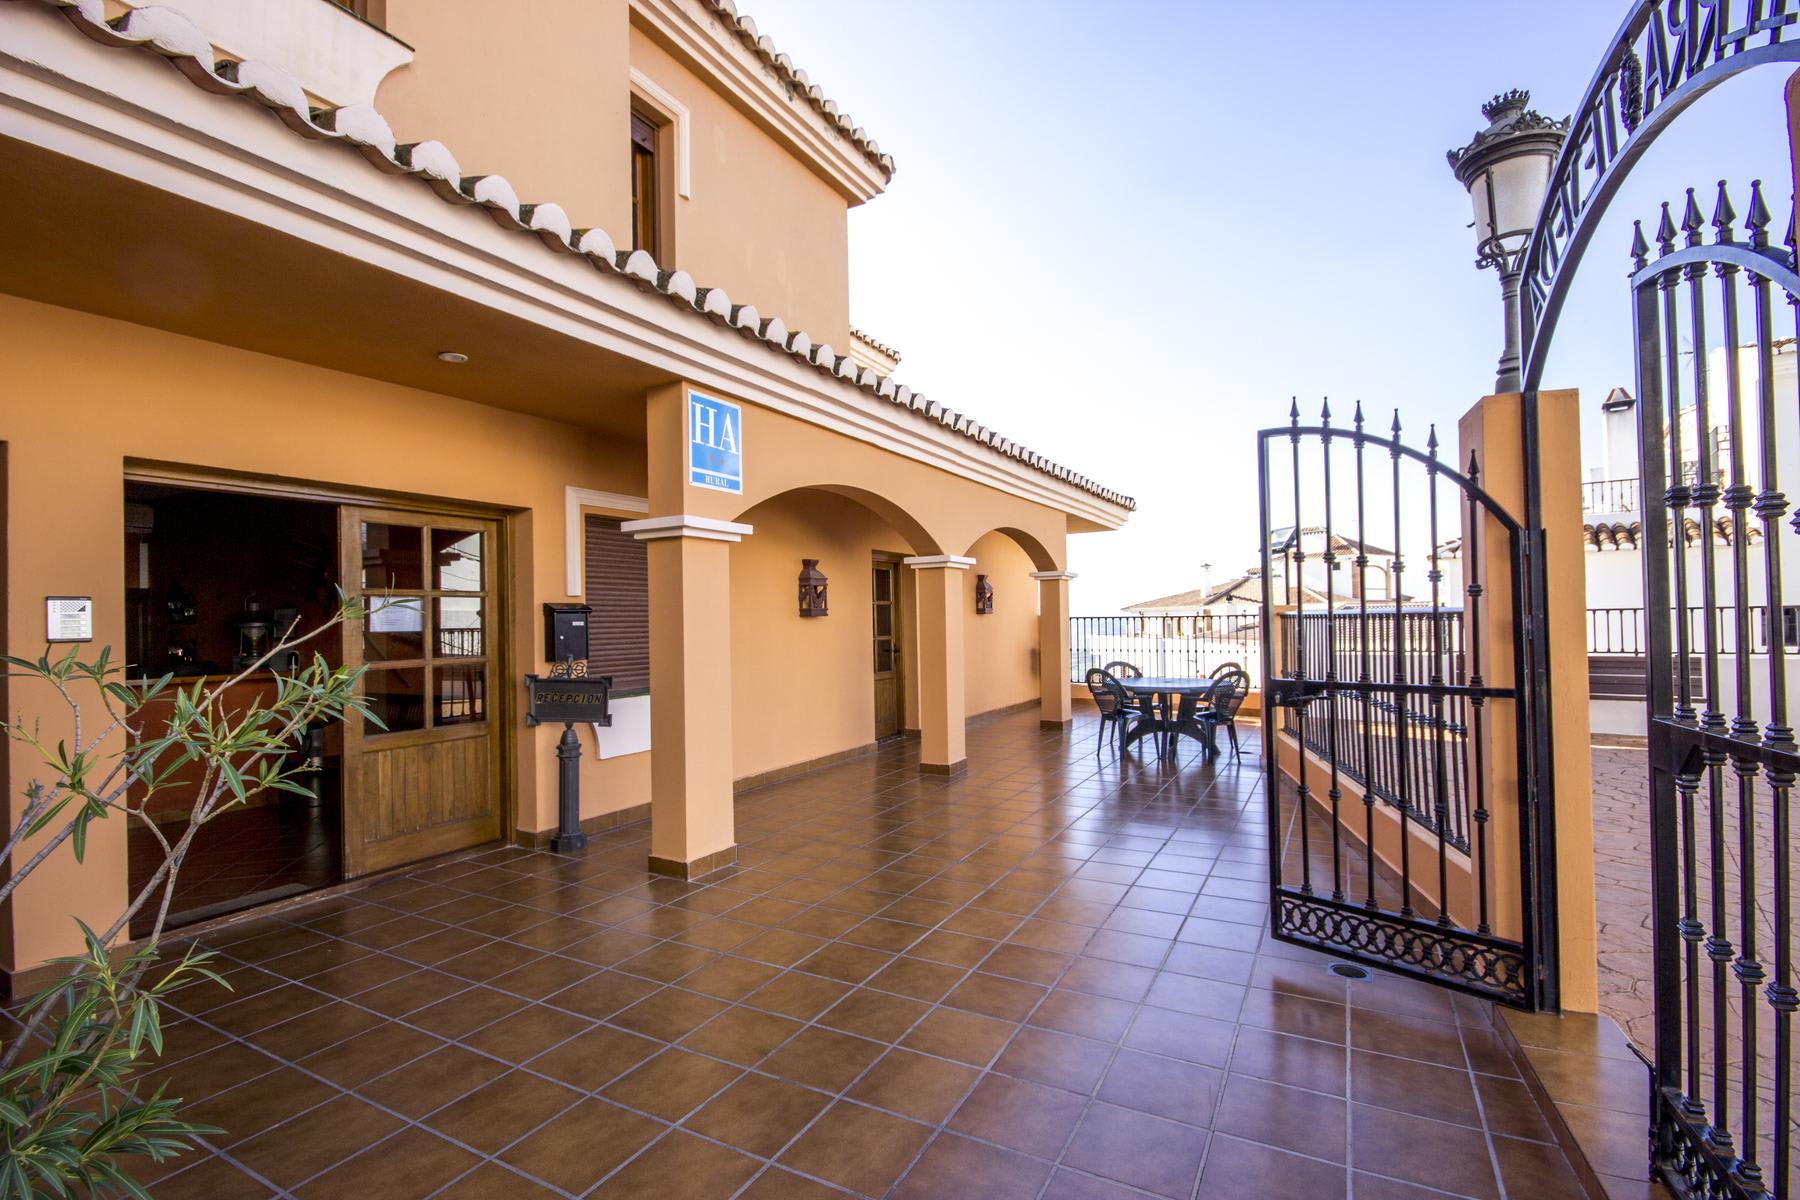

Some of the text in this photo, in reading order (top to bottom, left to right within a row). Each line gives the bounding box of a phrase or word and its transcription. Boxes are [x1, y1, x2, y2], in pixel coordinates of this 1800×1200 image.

[692, 401, 739, 455] HA
[705, 475, 729, 487] RURAL
[536, 692, 602, 704] RECEPCION
